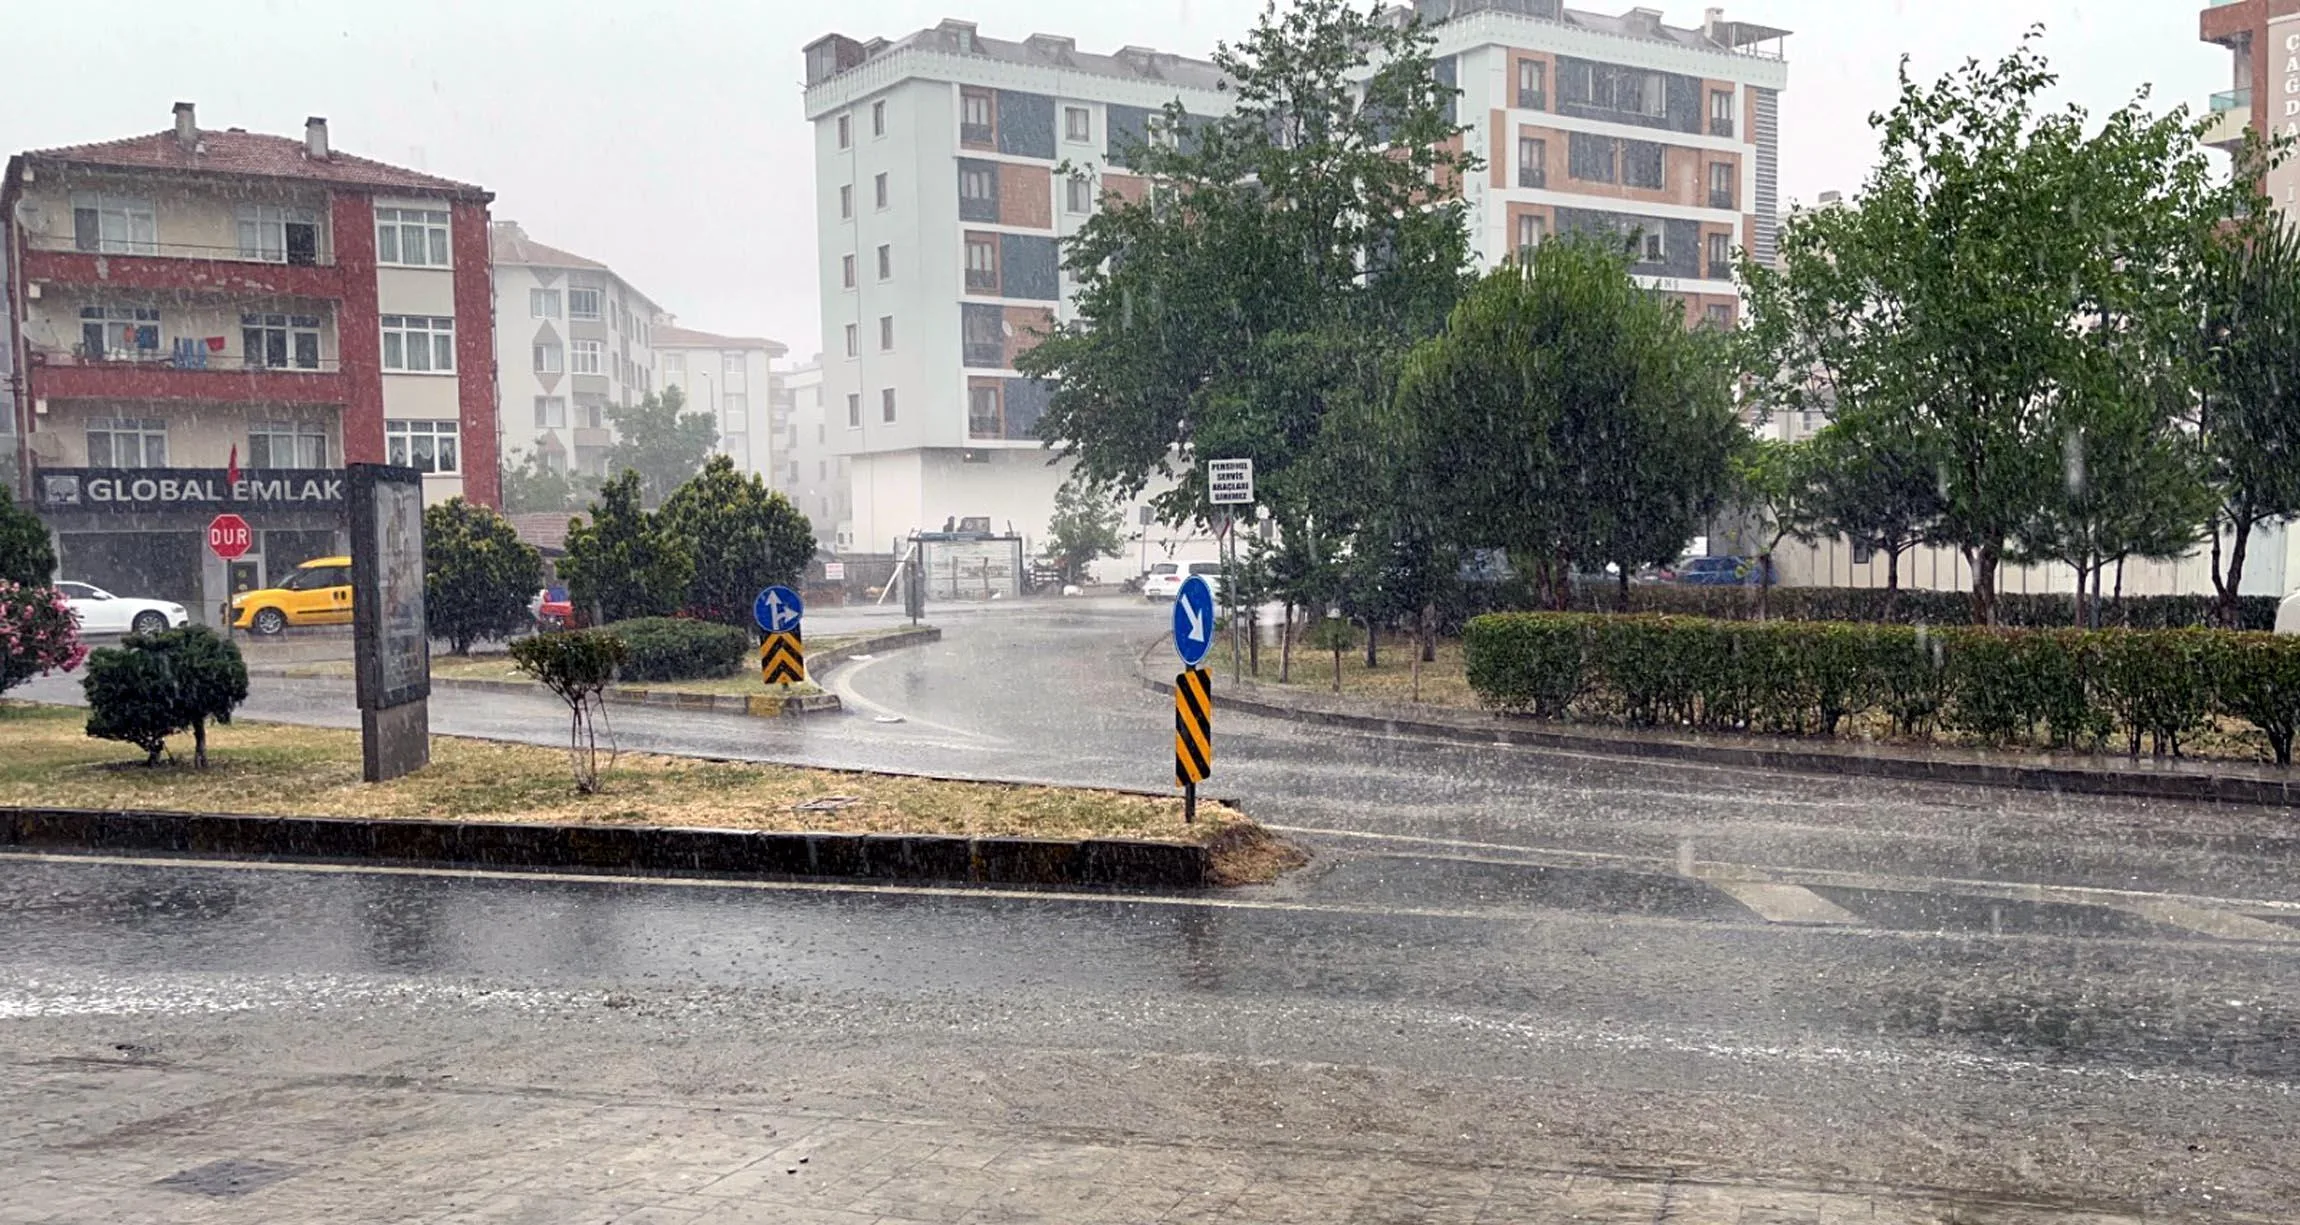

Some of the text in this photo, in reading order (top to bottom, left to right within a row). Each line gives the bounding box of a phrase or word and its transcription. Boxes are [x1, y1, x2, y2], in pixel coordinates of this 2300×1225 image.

[1217, 472, 1243, 480] SERVİS
[88, 479, 344, 501] GLOBAL EMLAK
[1212, 482, 1248, 491] ARAÇLARI
[211, 528, 248, 546] DUR
